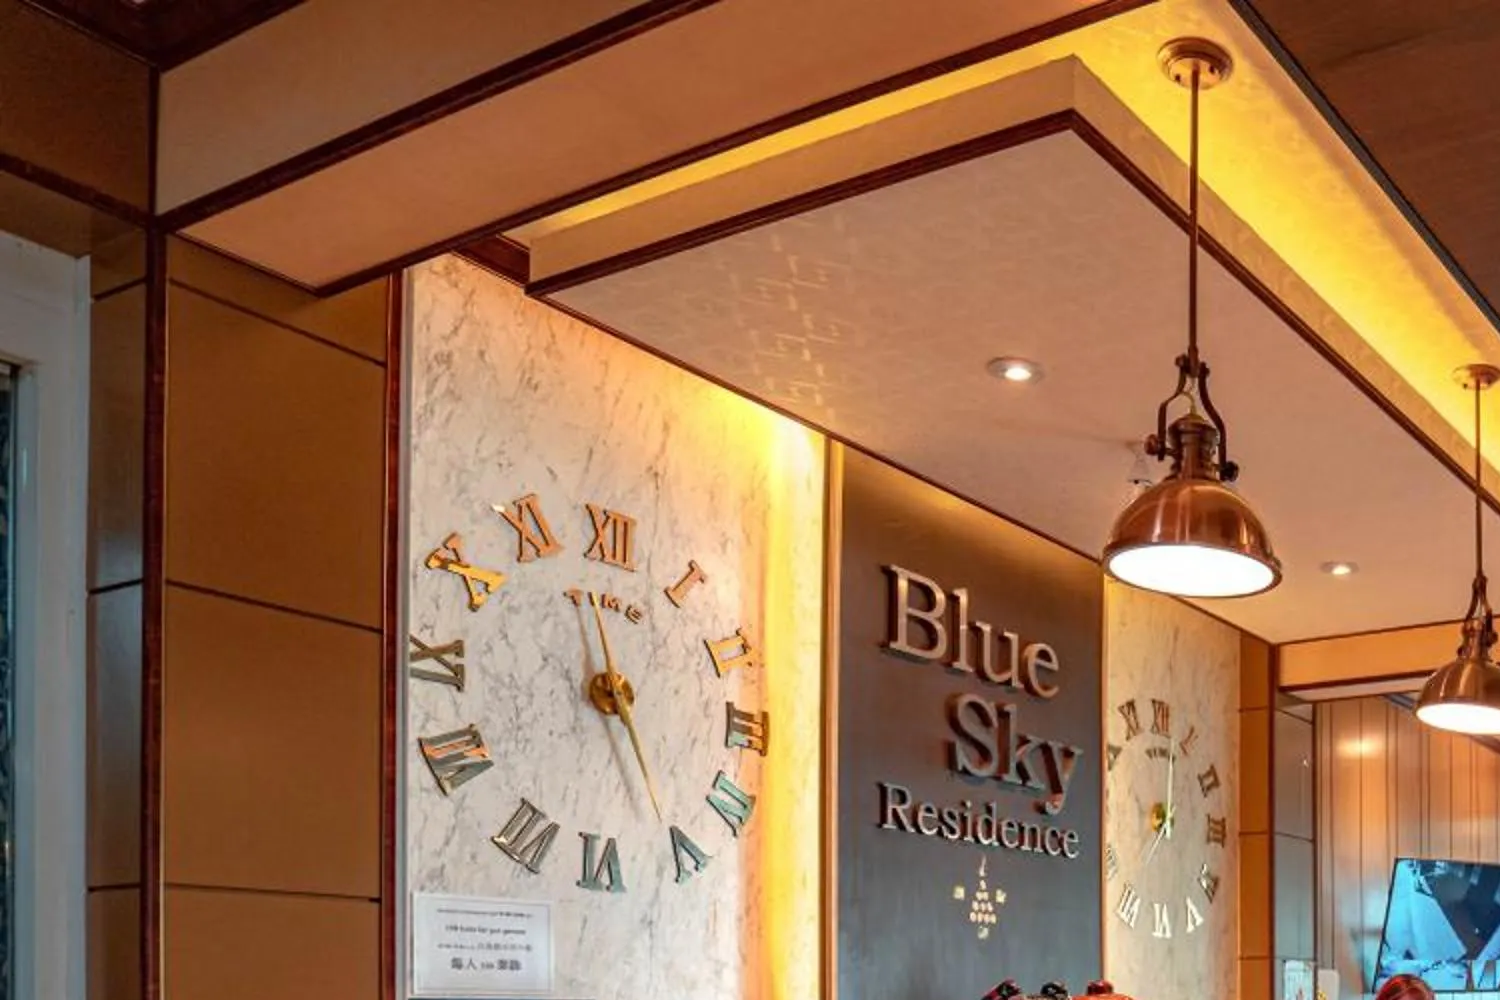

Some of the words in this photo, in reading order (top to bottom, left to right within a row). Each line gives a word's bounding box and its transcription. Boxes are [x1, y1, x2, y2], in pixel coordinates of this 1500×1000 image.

[491, 494, 564, 564] XI
[584, 503, 637, 573] XII
[425, 532, 507, 612] X
[664, 560, 707, 608] I
[704, 627, 760, 678] II
[886, 564, 1059, 698] Blue
[726, 702, 769, 757] III
[950, 693, 1083, 815] Sky
[490, 797, 560, 874] VII
[669, 826, 713, 884] V
[881, 782, 1080, 860] Residence
[576, 832, 626, 892] VI
